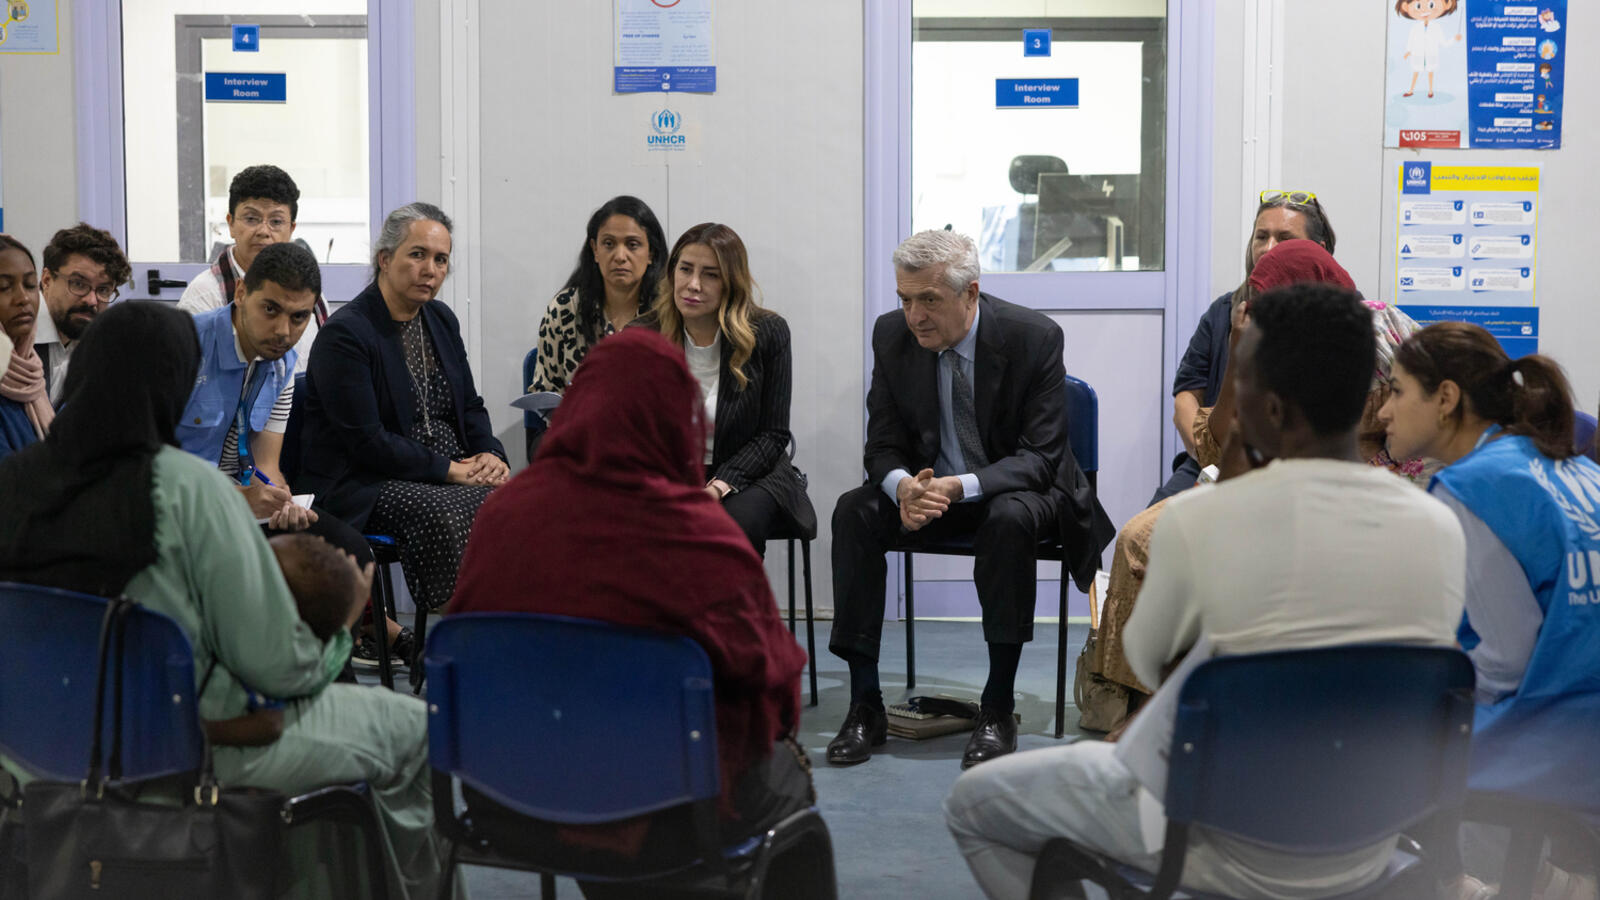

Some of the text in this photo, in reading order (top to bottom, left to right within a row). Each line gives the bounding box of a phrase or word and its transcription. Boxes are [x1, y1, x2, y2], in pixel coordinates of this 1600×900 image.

[242, 34, 250, 43] 4
[1034, 38, 1041, 48] 3
[1014, 84, 1060, 92] Interview
[647, 135, 686, 144] UNHCR
[1410, 132, 1426, 141] 105
[1568, 592, 1588, 606] The
